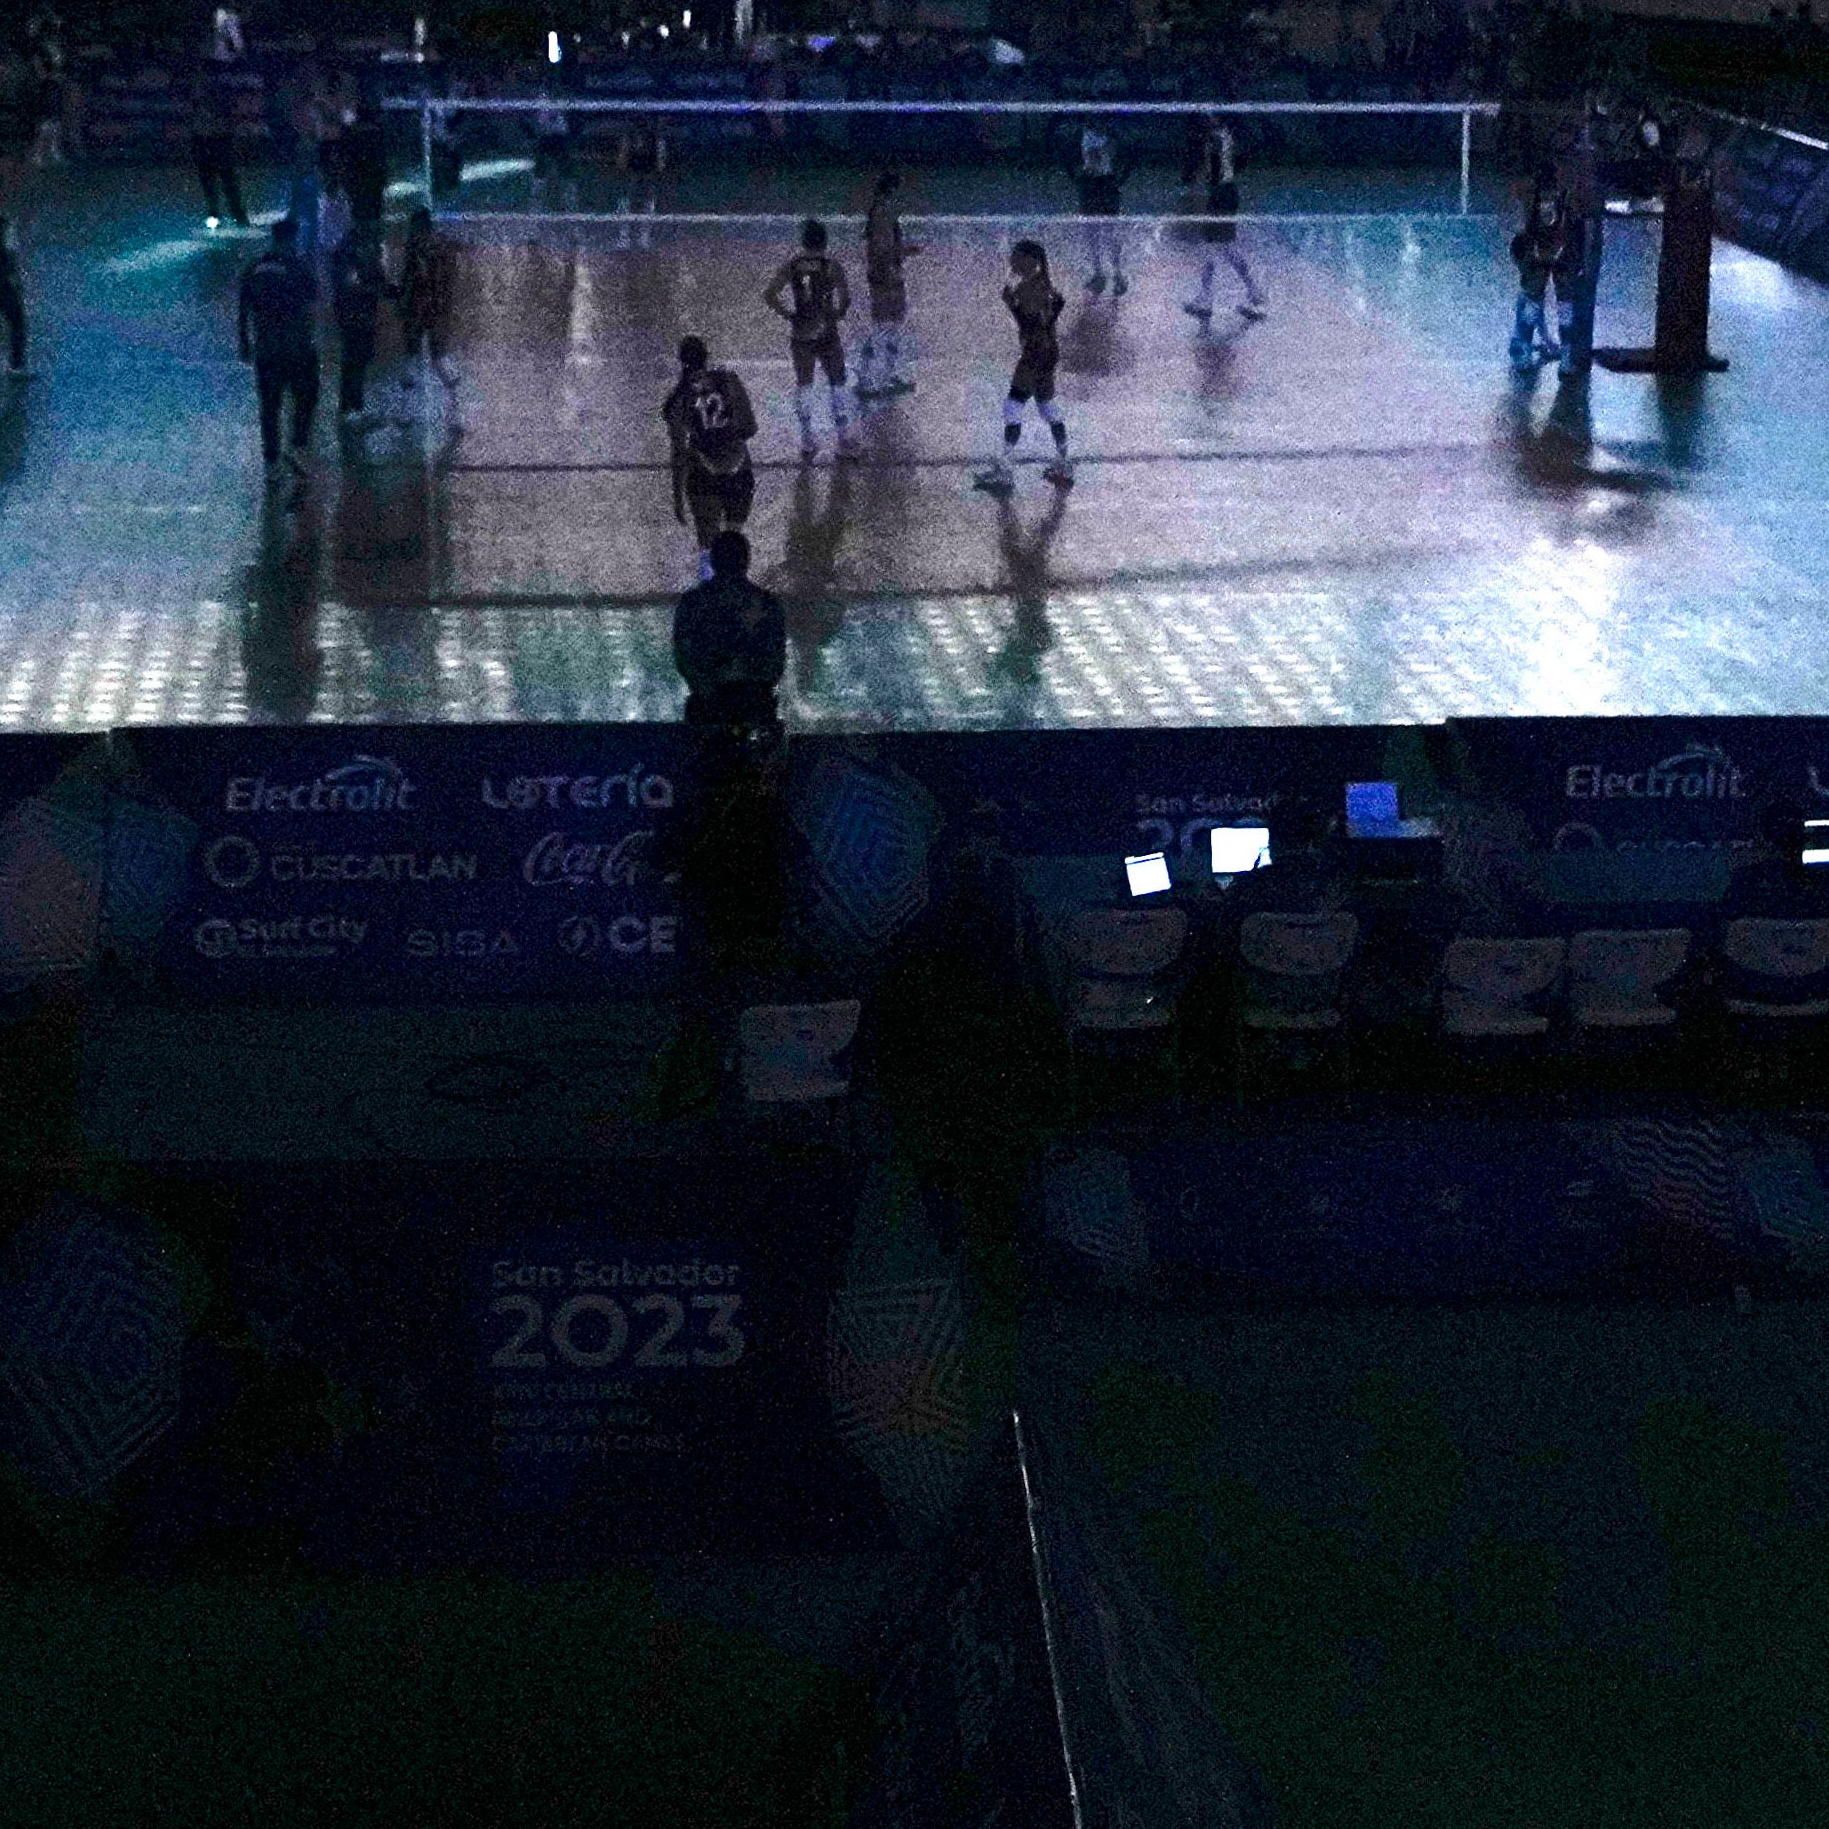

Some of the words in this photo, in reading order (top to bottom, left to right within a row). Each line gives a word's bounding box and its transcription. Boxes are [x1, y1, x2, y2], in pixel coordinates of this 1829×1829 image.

[692, 392, 731, 432] 12
[224, 772, 418, 813] Electrolit
[1564, 759, 1748, 800] Electrolit
[270, 851, 479, 883] CUSCATLAN
[406, 928, 522, 960] SISA
[490, 1258, 564, 1289] San
[572, 1256, 743, 1289] Salvador
[489, 1292, 749, 1370] 2023
